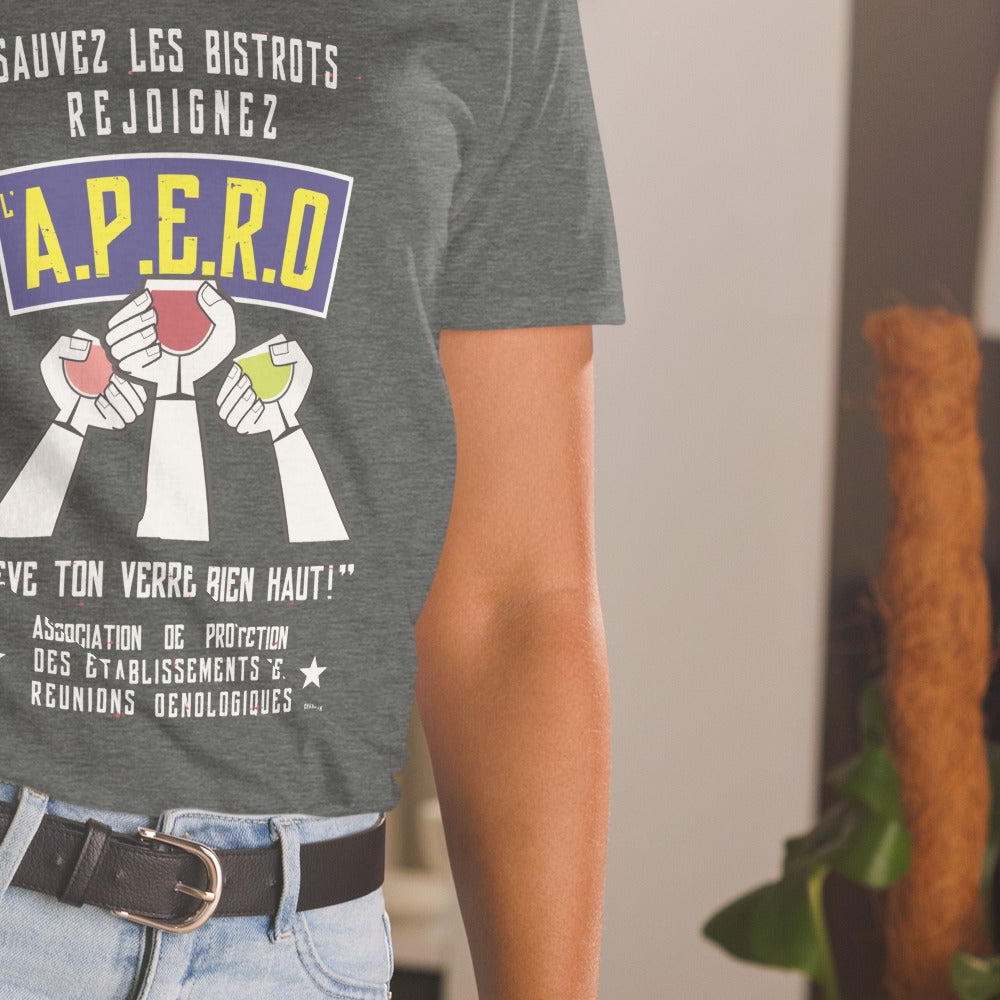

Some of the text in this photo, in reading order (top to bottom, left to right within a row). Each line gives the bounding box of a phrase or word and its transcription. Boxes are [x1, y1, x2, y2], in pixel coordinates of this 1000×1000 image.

[129, 27, 184, 73] LES
[205, 29, 338, 89] BISTROTS
[66, 88, 277, 140] REJOIGNEZ
[54, 559, 104, 598] TON
[206, 565, 255, 603] BIEN
[164, 623, 185, 651] DE
[33, 647, 71, 677] DES
[30, 677, 293, 718] REUNIONS OENOLOGIQUES
